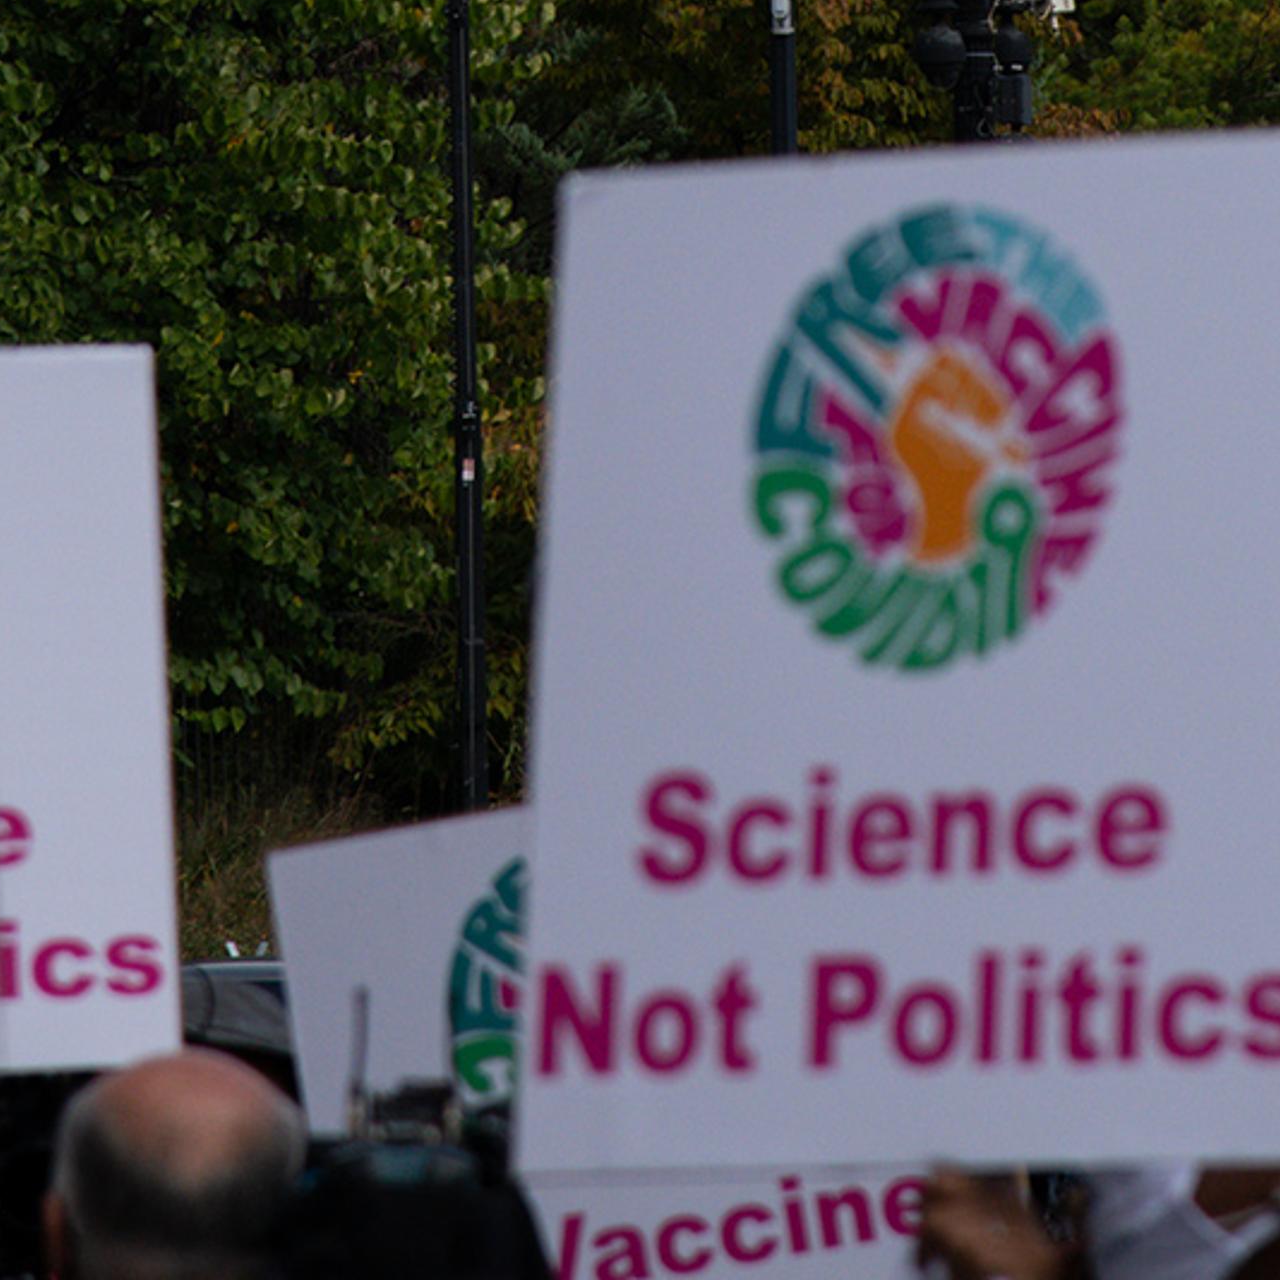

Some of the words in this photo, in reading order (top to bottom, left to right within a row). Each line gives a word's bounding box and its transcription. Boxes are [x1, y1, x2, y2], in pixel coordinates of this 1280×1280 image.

[753, 202, 978, 456] FREE
[638, 767, 1169, 888] Science
[535, 962, 756, 1079] Not
